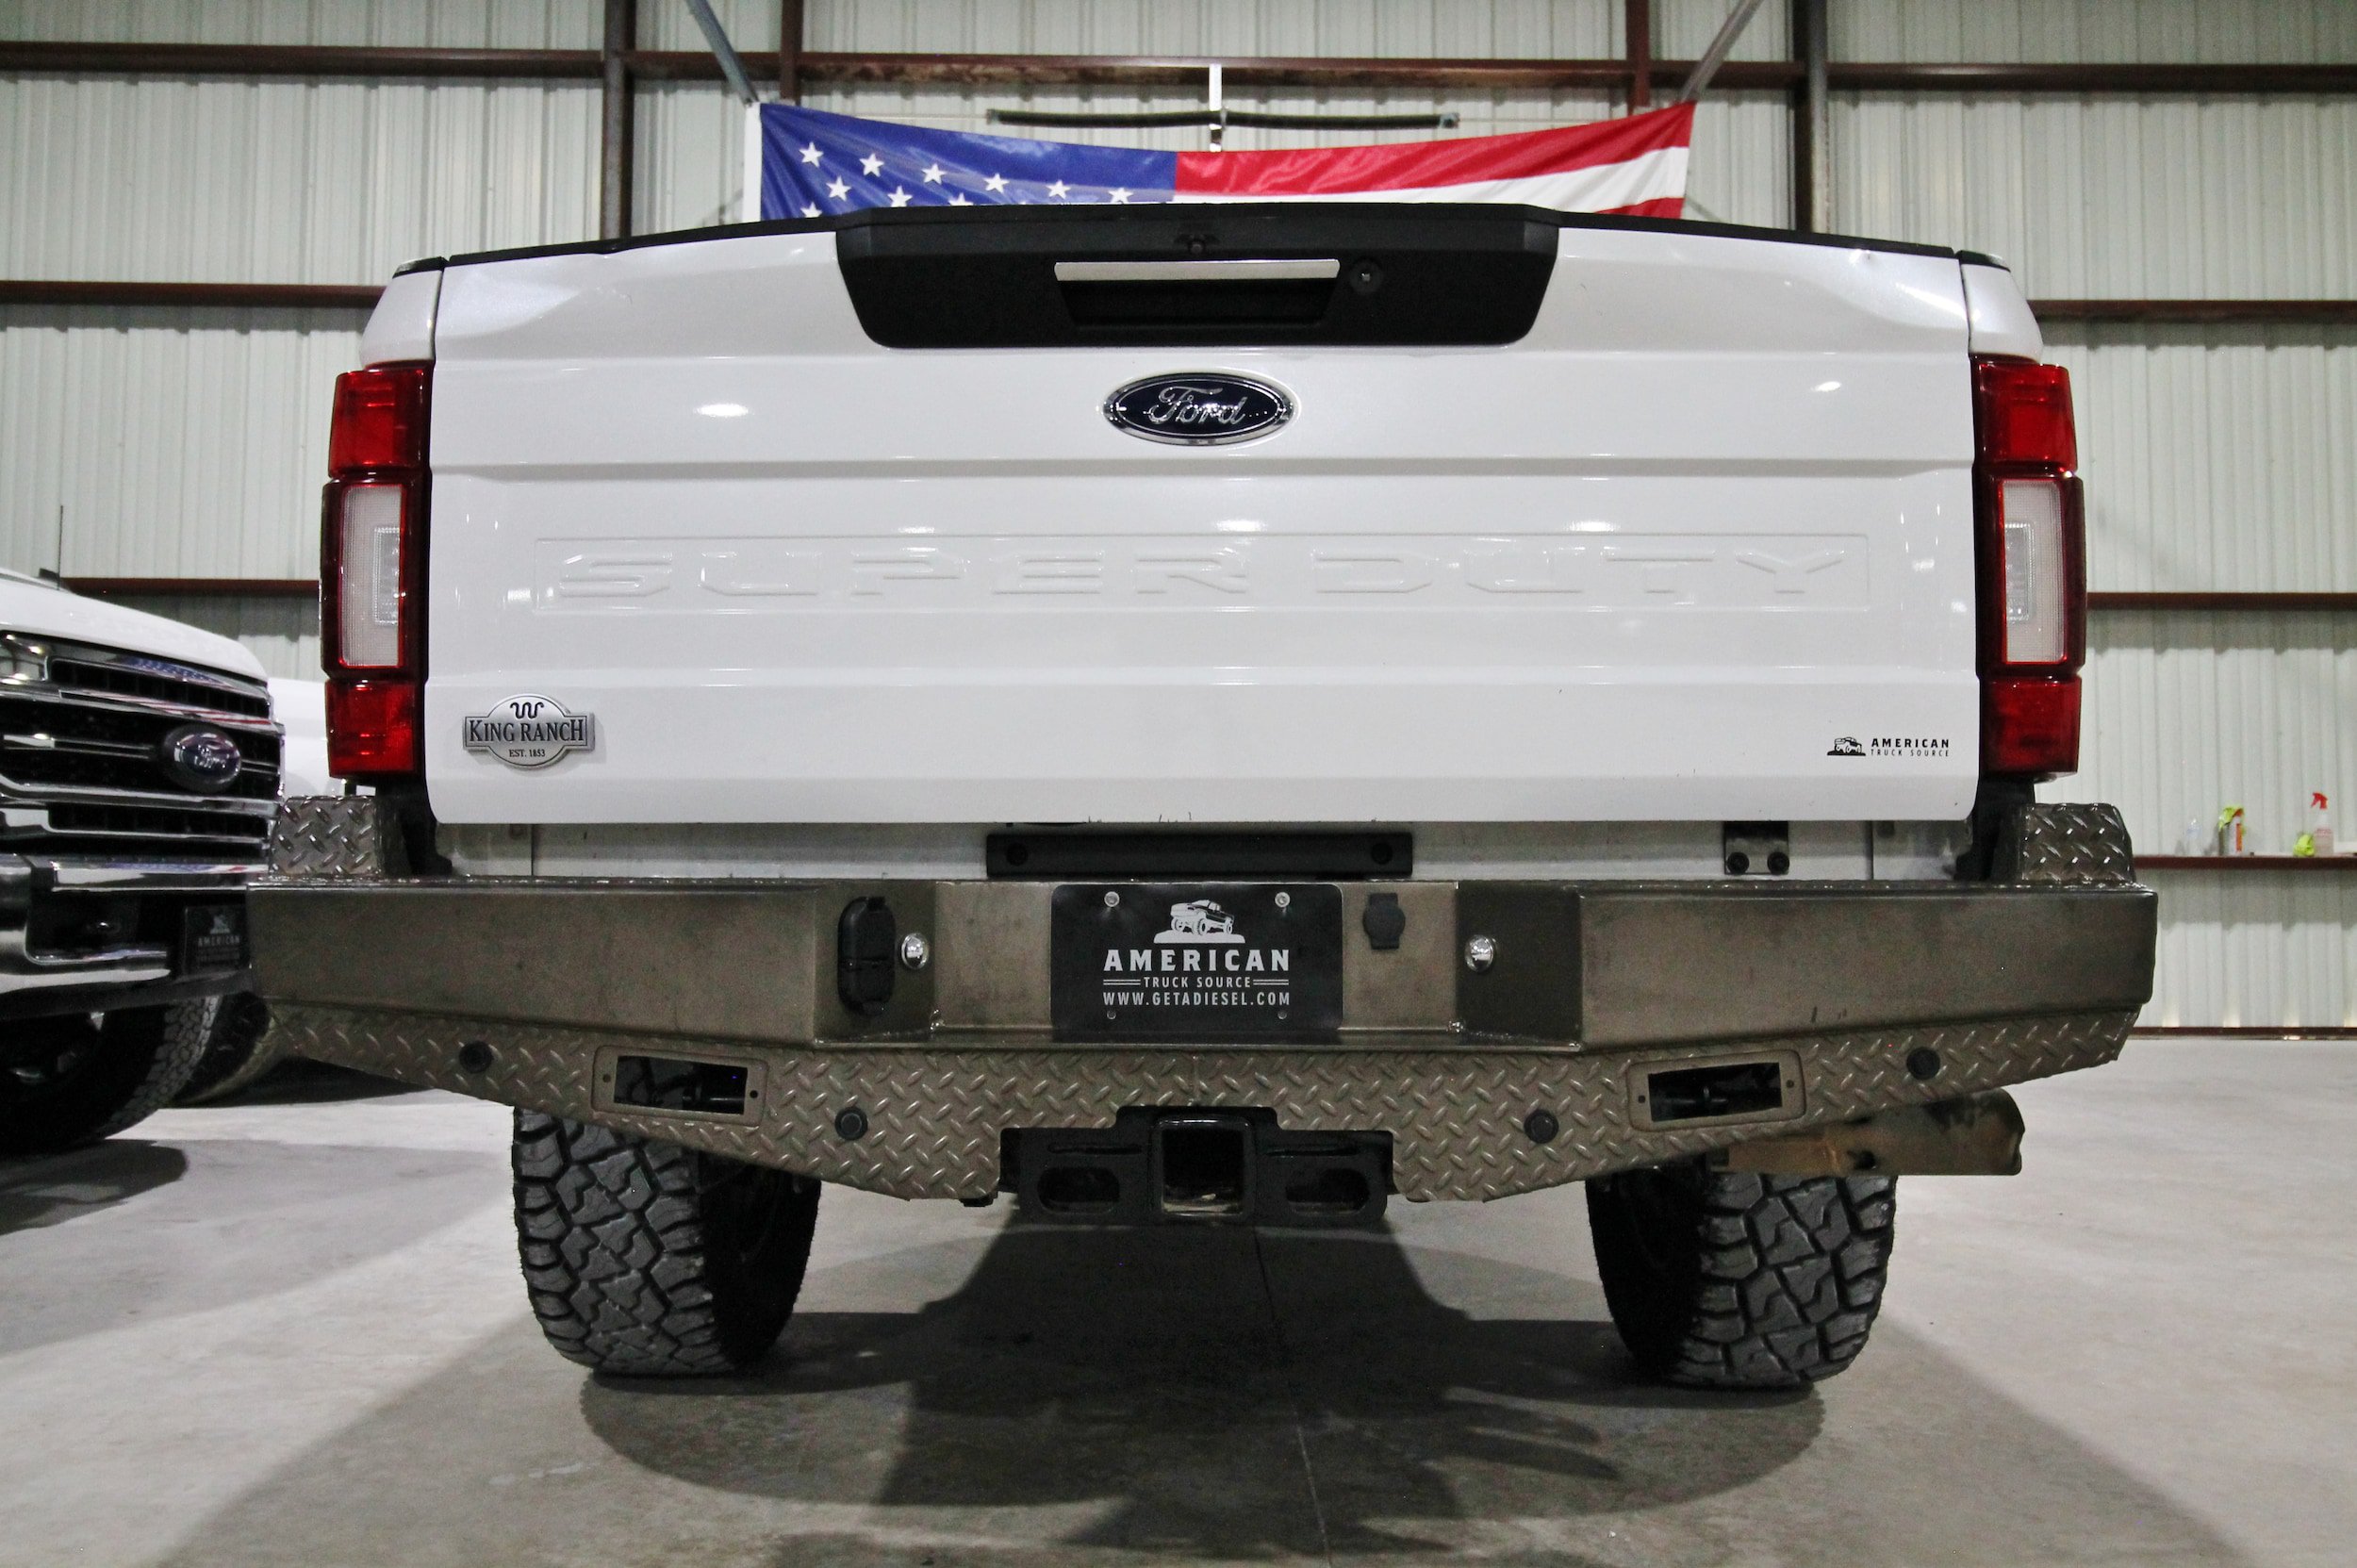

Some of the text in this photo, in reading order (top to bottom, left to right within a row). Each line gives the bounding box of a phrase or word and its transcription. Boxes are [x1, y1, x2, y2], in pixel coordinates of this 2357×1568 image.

[1146, 386, 1248, 424] Ford
[559, 548, 1846, 598] SUPER DUTY
[470, 719, 585, 742] KING RANCH
[1871, 738, 1950, 749] AMERICAN
[508, 749, 546, 758] EST. 1853
[1871, 749, 1950, 757] TRUCK SOURCE
[1103, 949, 1290, 972] AMERICAN
[1144, 976, 1251, 988] TRUCK SOURCE
[1103, 992, 1290, 1006] WWW.GETADIESEL.COM
